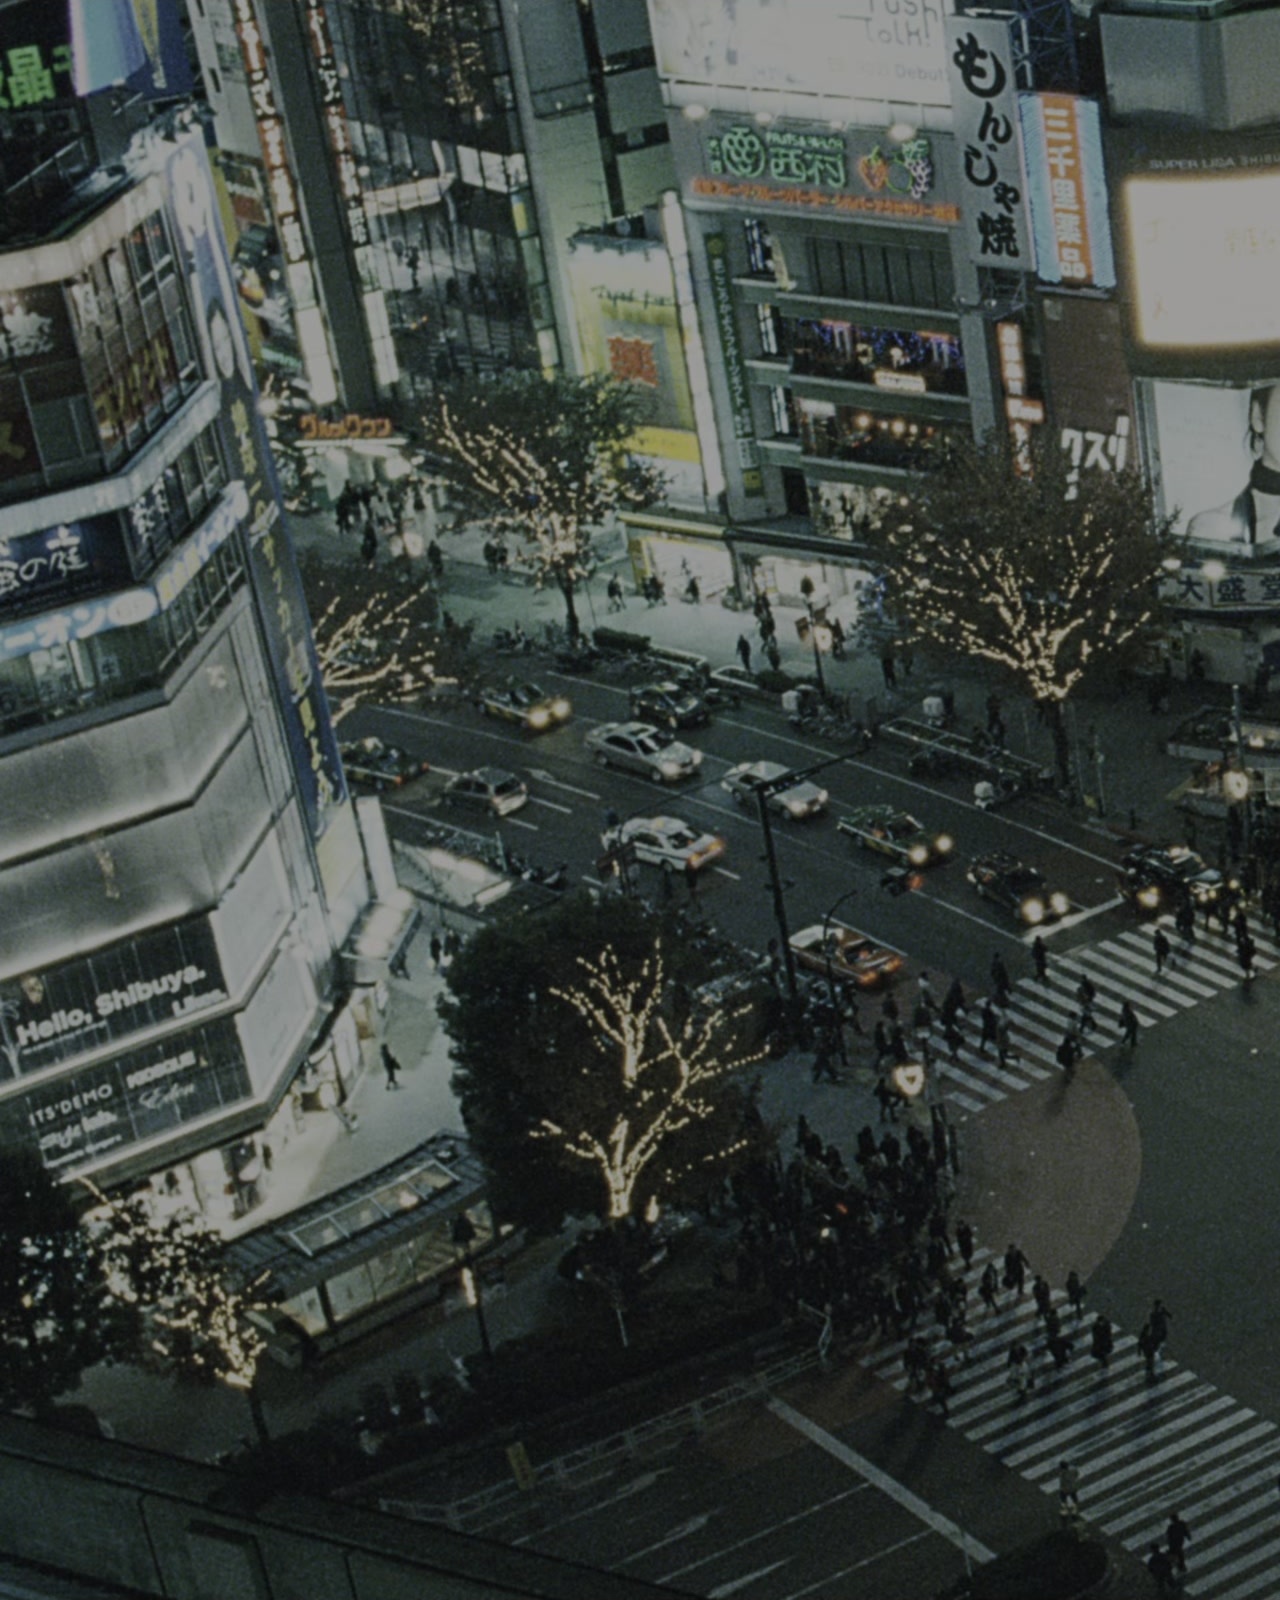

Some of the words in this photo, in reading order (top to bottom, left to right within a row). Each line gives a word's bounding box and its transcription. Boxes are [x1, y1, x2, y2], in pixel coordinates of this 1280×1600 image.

[954, 32, 1019, 257] もんじゃ焼
[1044, 107, 1087, 279] 三千里薬品
[16, 1007, 93, 1047] Hello,
[95, 964, 207, 1017] Shibuya.
[29, 1083, 113, 1127] ITS'DEMO
